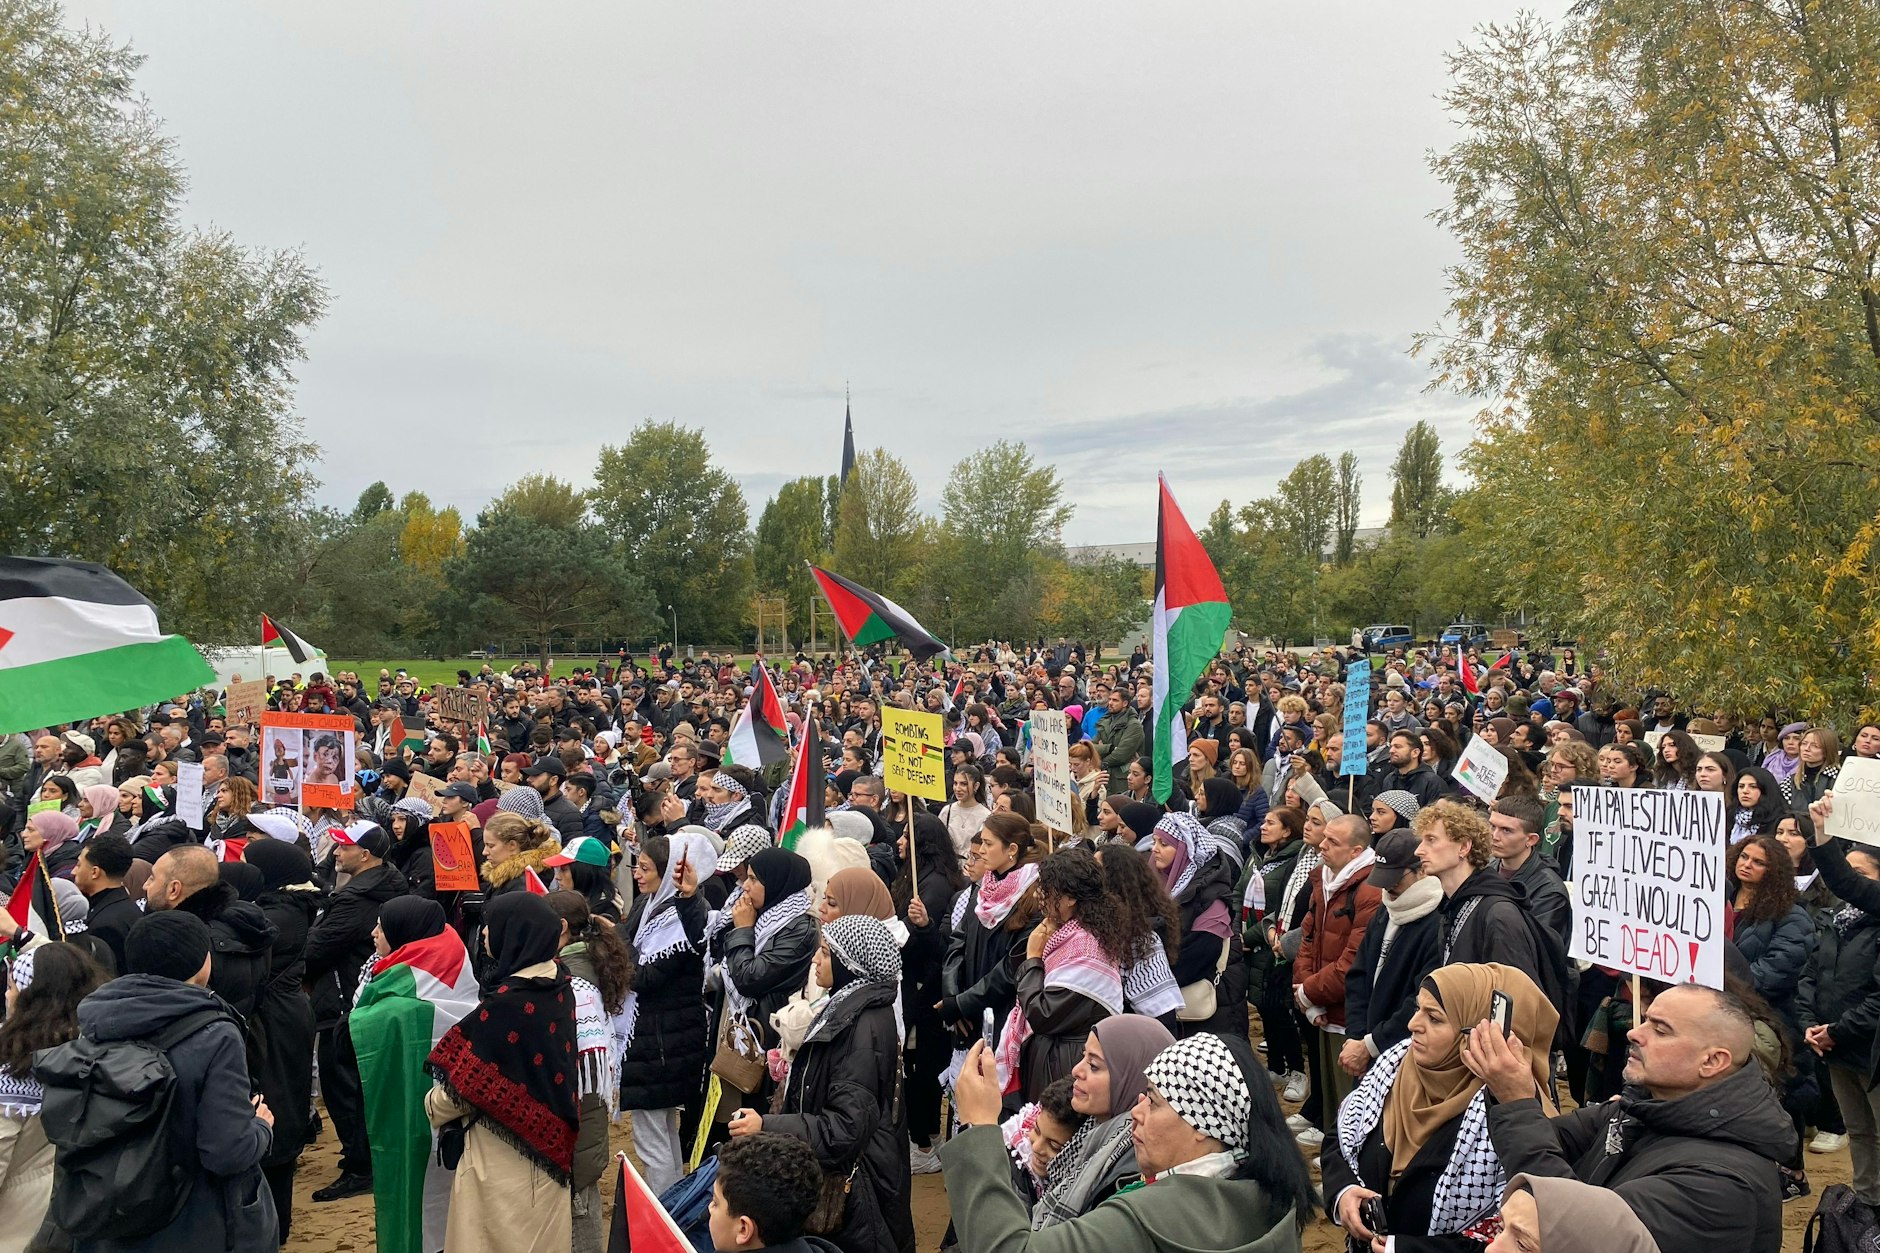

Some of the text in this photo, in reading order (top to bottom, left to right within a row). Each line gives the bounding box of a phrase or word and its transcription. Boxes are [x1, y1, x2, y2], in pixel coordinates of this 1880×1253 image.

[446, 687, 465, 700] STOP
[441, 697, 477, 717] KILLING
[262, 712, 354, 729] STOP KILLING CHILDREN
[895, 722, 929, 741] BOMBING
[901, 741, 918, 753] KIDS
[1051, 741, 1058, 755] IS
[899, 753, 923, 768] IS NOT
[892, 765, 936, 786] SELF DEFENSE
[1475, 772, 1497, 790] PALESTINE
[1480, 765, 1497, 780] FREE
[303, 784, 352, 807] STOP THE WAR
[1605, 789, 1722, 846] PALESTINIAN
[1588, 831, 1717, 892] IF I LIVED IN
[1581, 874, 1712, 942] GAZA I WOULD
[1584, 916, 1610, 960] BE
